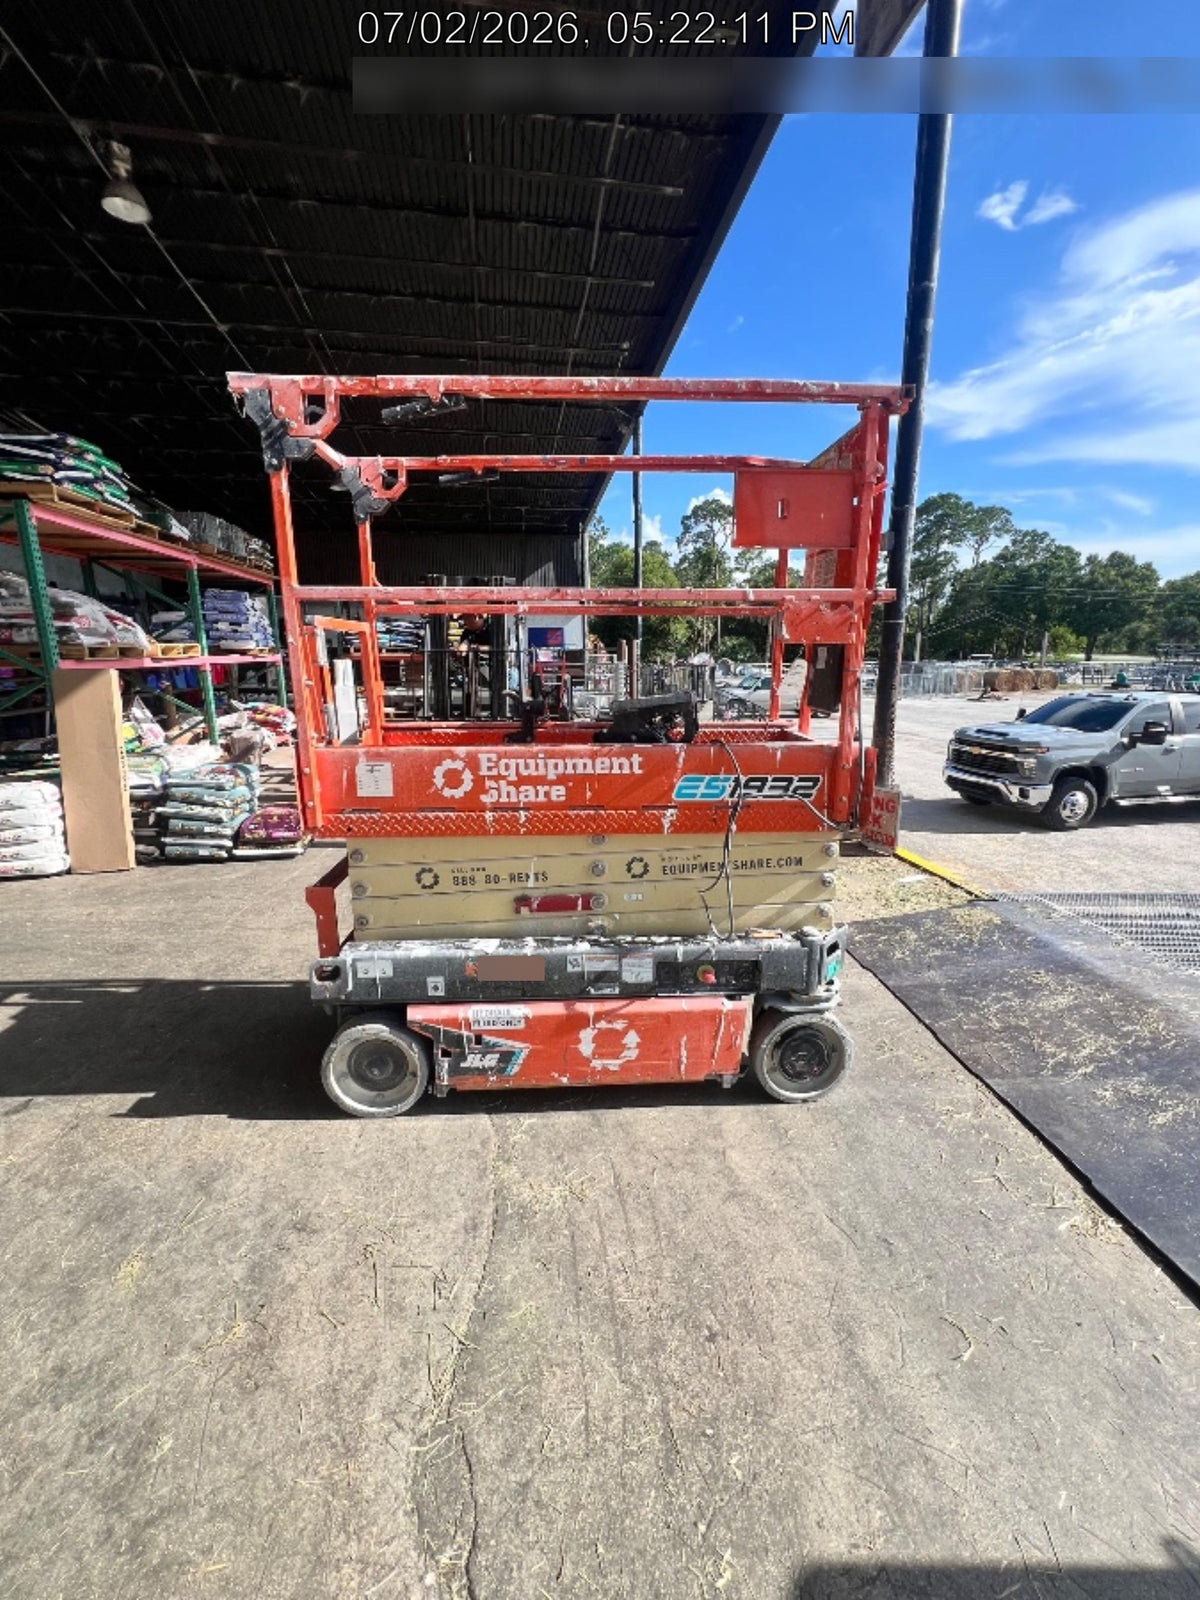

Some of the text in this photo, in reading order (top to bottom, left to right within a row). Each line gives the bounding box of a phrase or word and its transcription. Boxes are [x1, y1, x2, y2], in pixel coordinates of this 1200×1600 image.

[478, 753, 643, 780] Equipment
[480, 780, 567, 803] Share
[673, 775, 823, 801] ES1932
